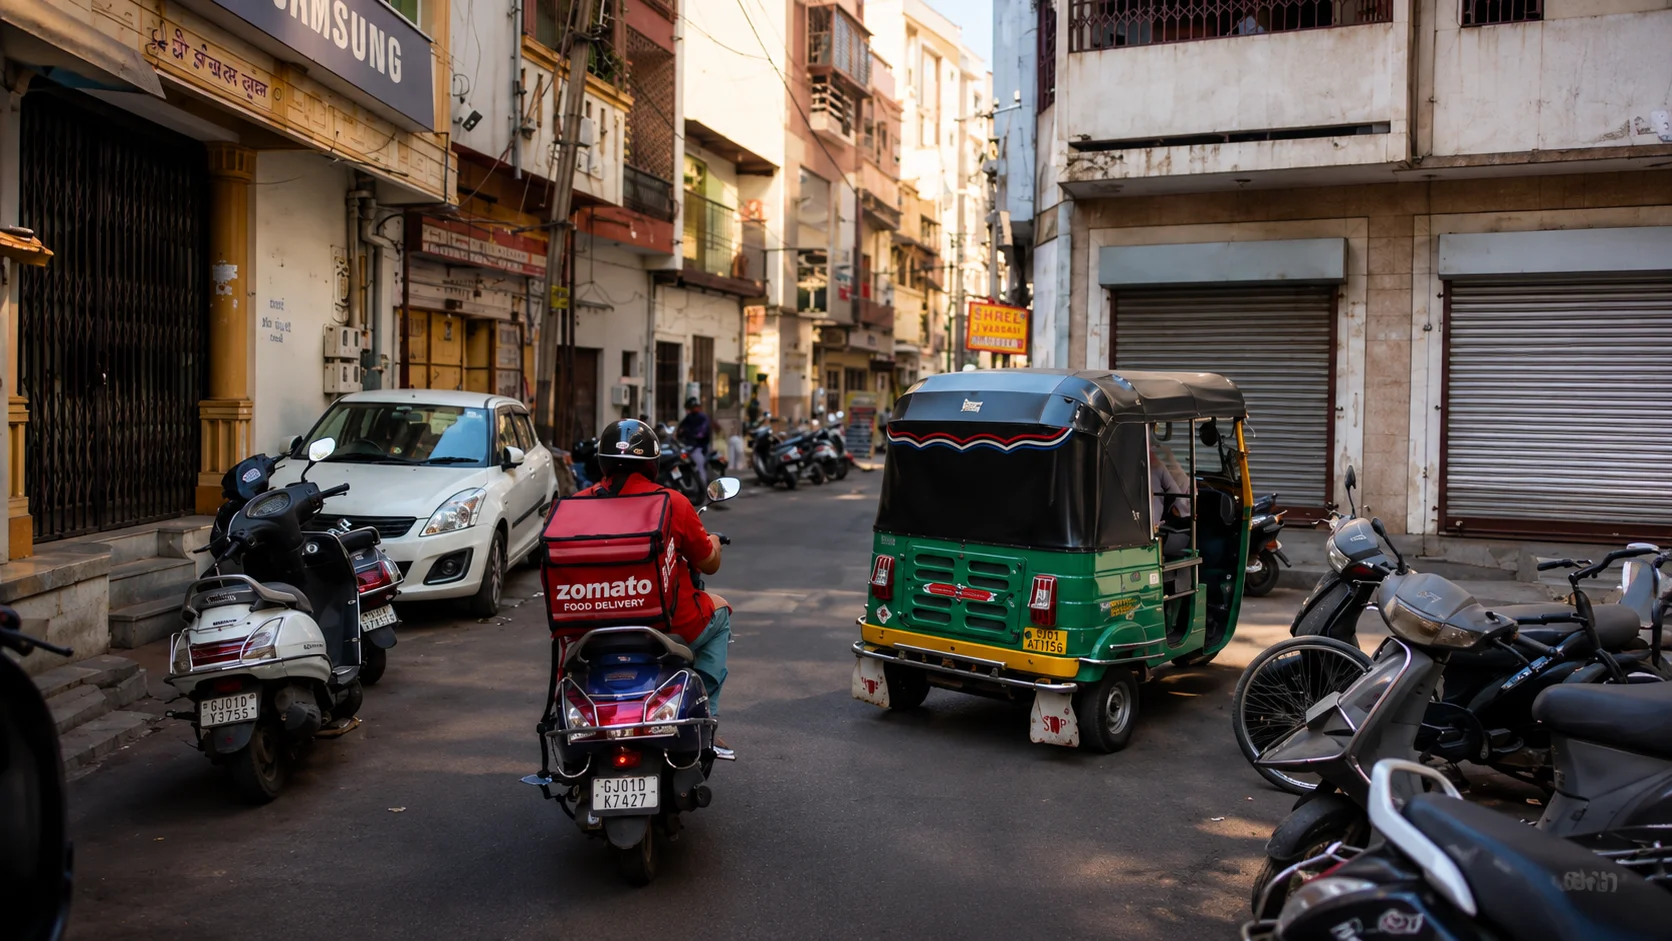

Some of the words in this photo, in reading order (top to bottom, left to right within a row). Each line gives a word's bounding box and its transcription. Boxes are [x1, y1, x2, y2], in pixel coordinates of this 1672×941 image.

[273, 0, 402, 84] AMSUNG
[556, 575, 652, 600] zomato
[564, 602, 592, 611] FOOD
[595, 598, 645, 610] DELIVERY
[211, 695, 247, 712] GJ01D
[604, 778, 646, 793] GJ01D
[604, 793, 647, 808] K7427
